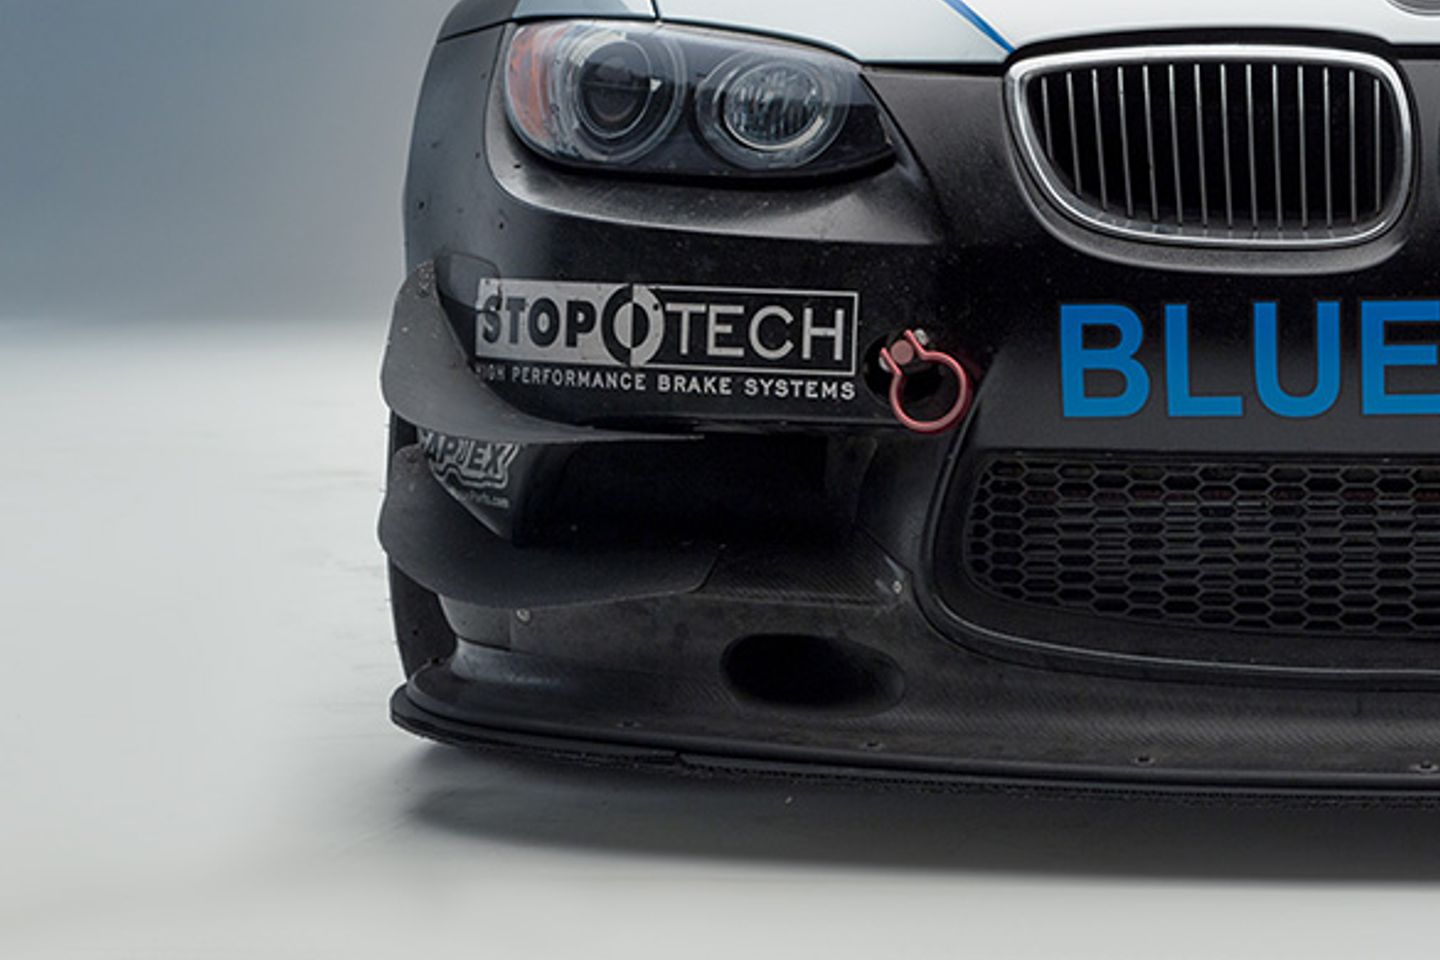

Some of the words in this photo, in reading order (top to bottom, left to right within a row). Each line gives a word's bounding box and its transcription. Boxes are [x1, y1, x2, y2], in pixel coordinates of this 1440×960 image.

[511, 367, 647, 391] PERFORMANCE
[656, 373, 733, 396] BRAKE
[743, 377, 856, 401] SYSTEMS
